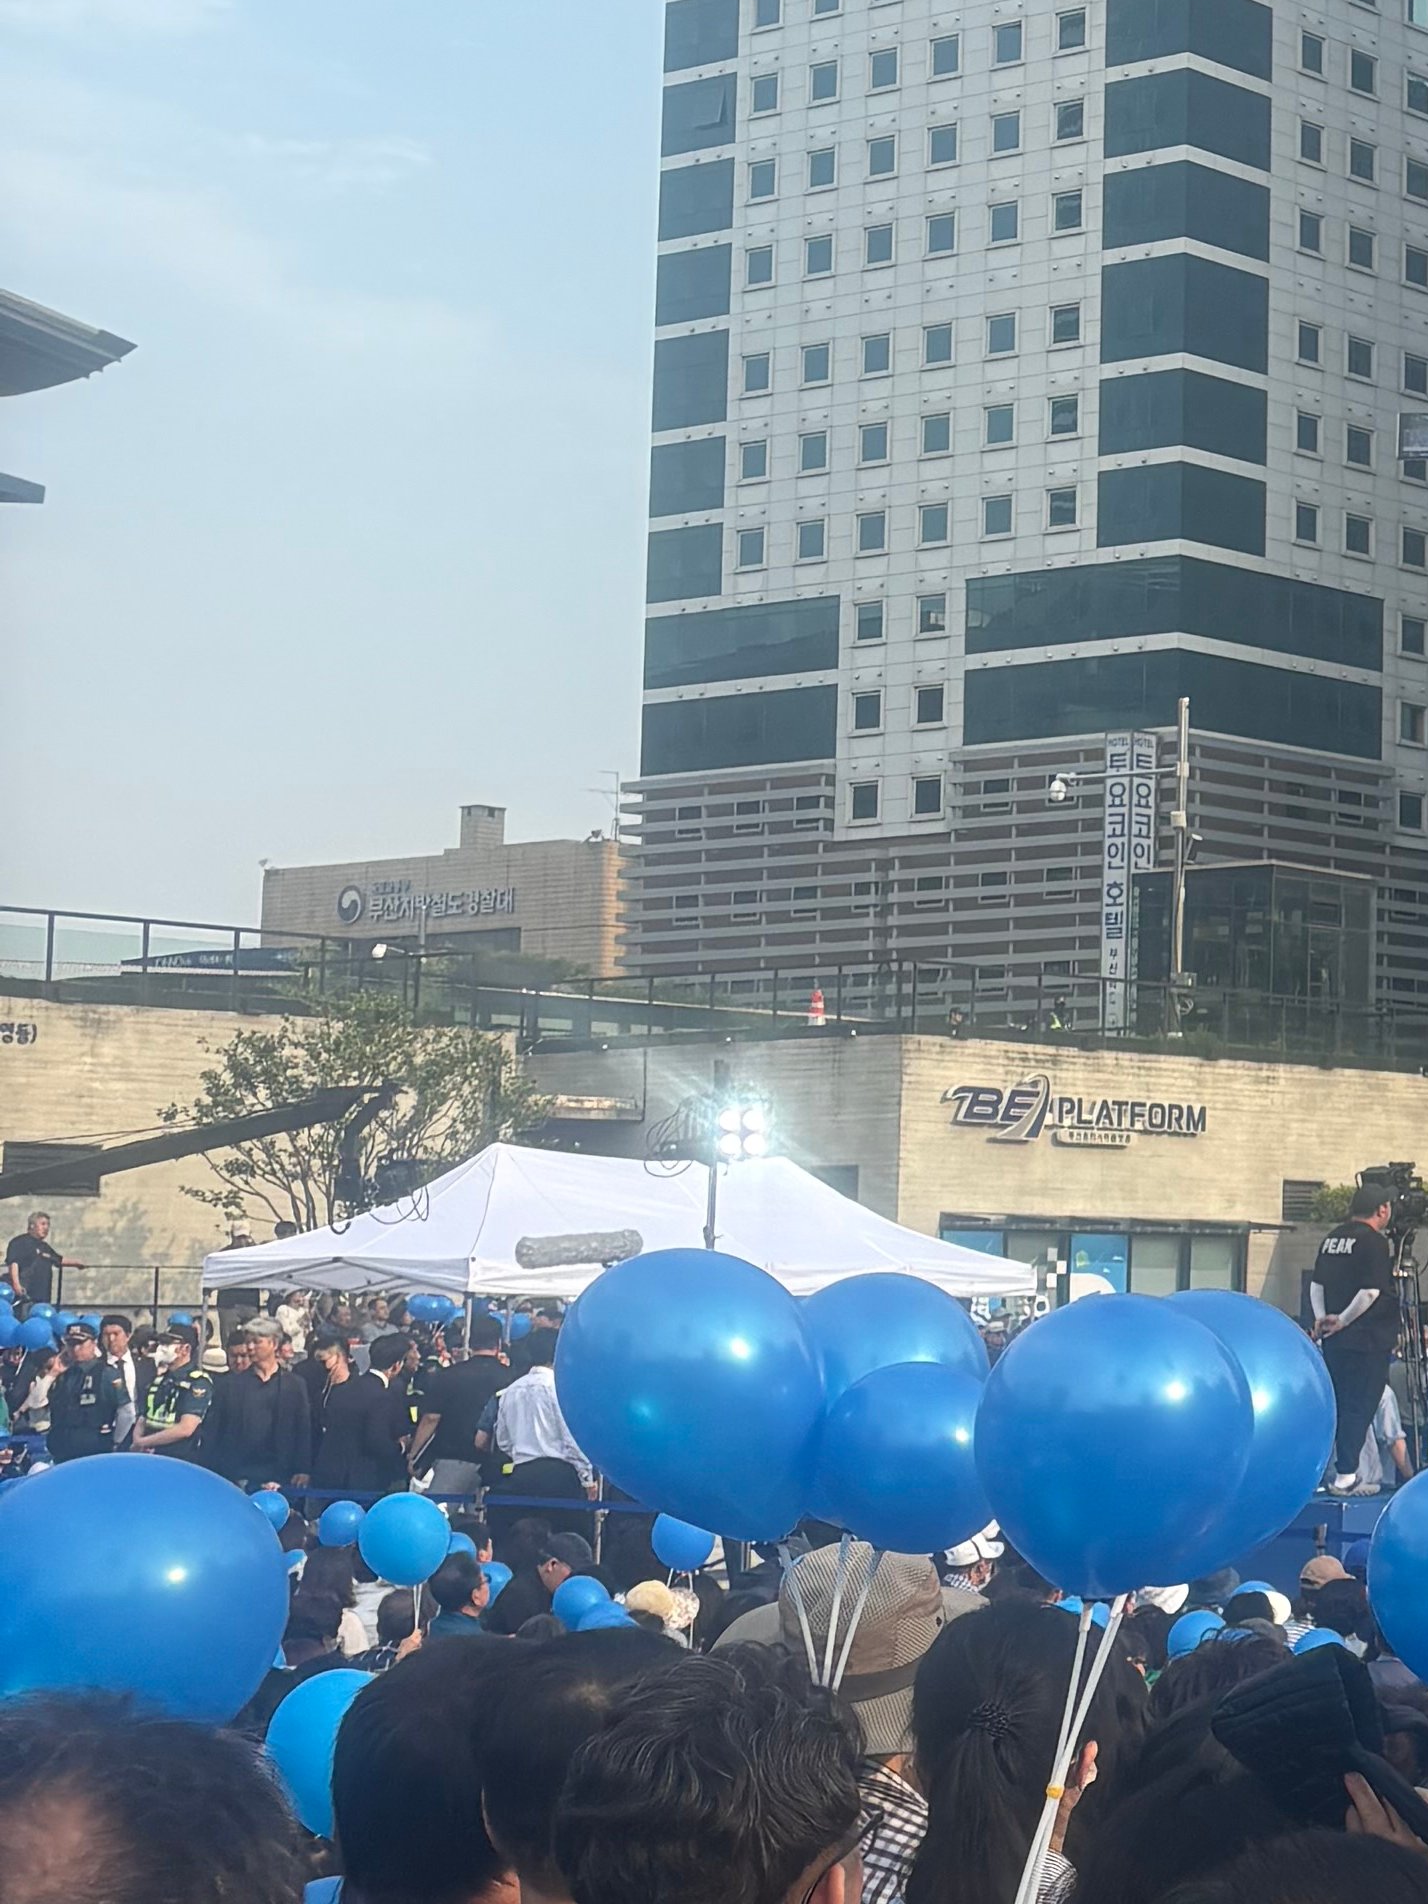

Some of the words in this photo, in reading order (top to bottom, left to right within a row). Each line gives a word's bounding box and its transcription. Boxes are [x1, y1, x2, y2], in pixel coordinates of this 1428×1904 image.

[1105, 880, 1125, 940] 호텔
[1057, 1096, 1207, 1133] PLATFORM
[1321, 1238, 1356, 1254] PEAK
